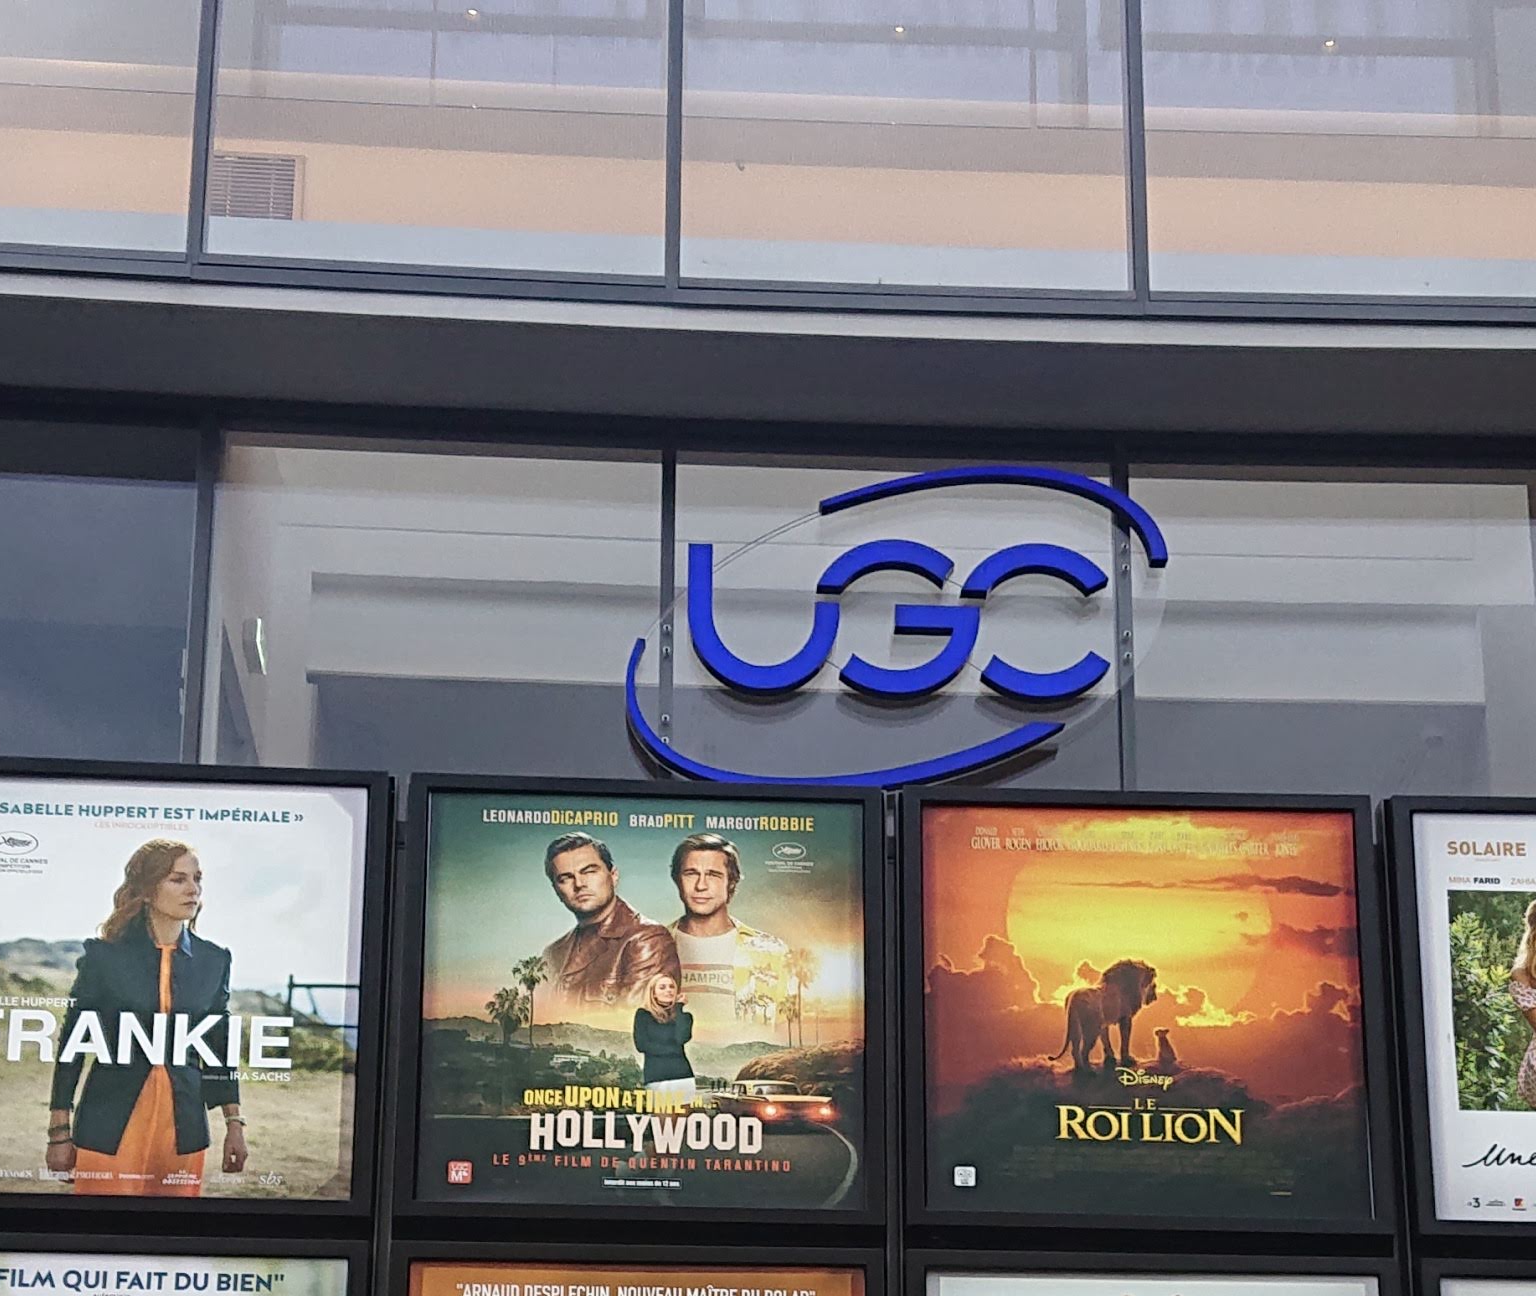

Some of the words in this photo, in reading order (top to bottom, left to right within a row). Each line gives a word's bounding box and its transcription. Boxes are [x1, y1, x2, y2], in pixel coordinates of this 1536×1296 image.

[687, 538, 1111, 702] UGC
[78, 804, 159, 821] HUPPERT
[163, 806, 196, 820] EST
[199, 806, 292, 824] IMPÉRIALE
[1447, 841, 1526, 858] SOLAIRE
[1473, 877, 1501, 885] FARID
[21, 996, 78, 1010] HUPPERT
[1115, 1067, 1174, 1091] Disney
[1134, 1098, 1157, 1110] LE
[529, 1110, 762, 1154] HOLLYWOOD
[1056, 1104, 1133, 1142] ROI
[1141, 1109, 1245, 1146] LION
[493, 1153, 510, 1166] LE
[554, 1156, 592, 1168] FILM
[600, 1157, 619, 1169] DE
[628, 1157, 697, 1170] QUENTIN
[705, 1158, 792, 1173] TARANTINO
[62, 1270, 108, 1292] QUI
[115, 1271, 167, 1290] FAIT
[174, 1272, 210, 1292] DU
